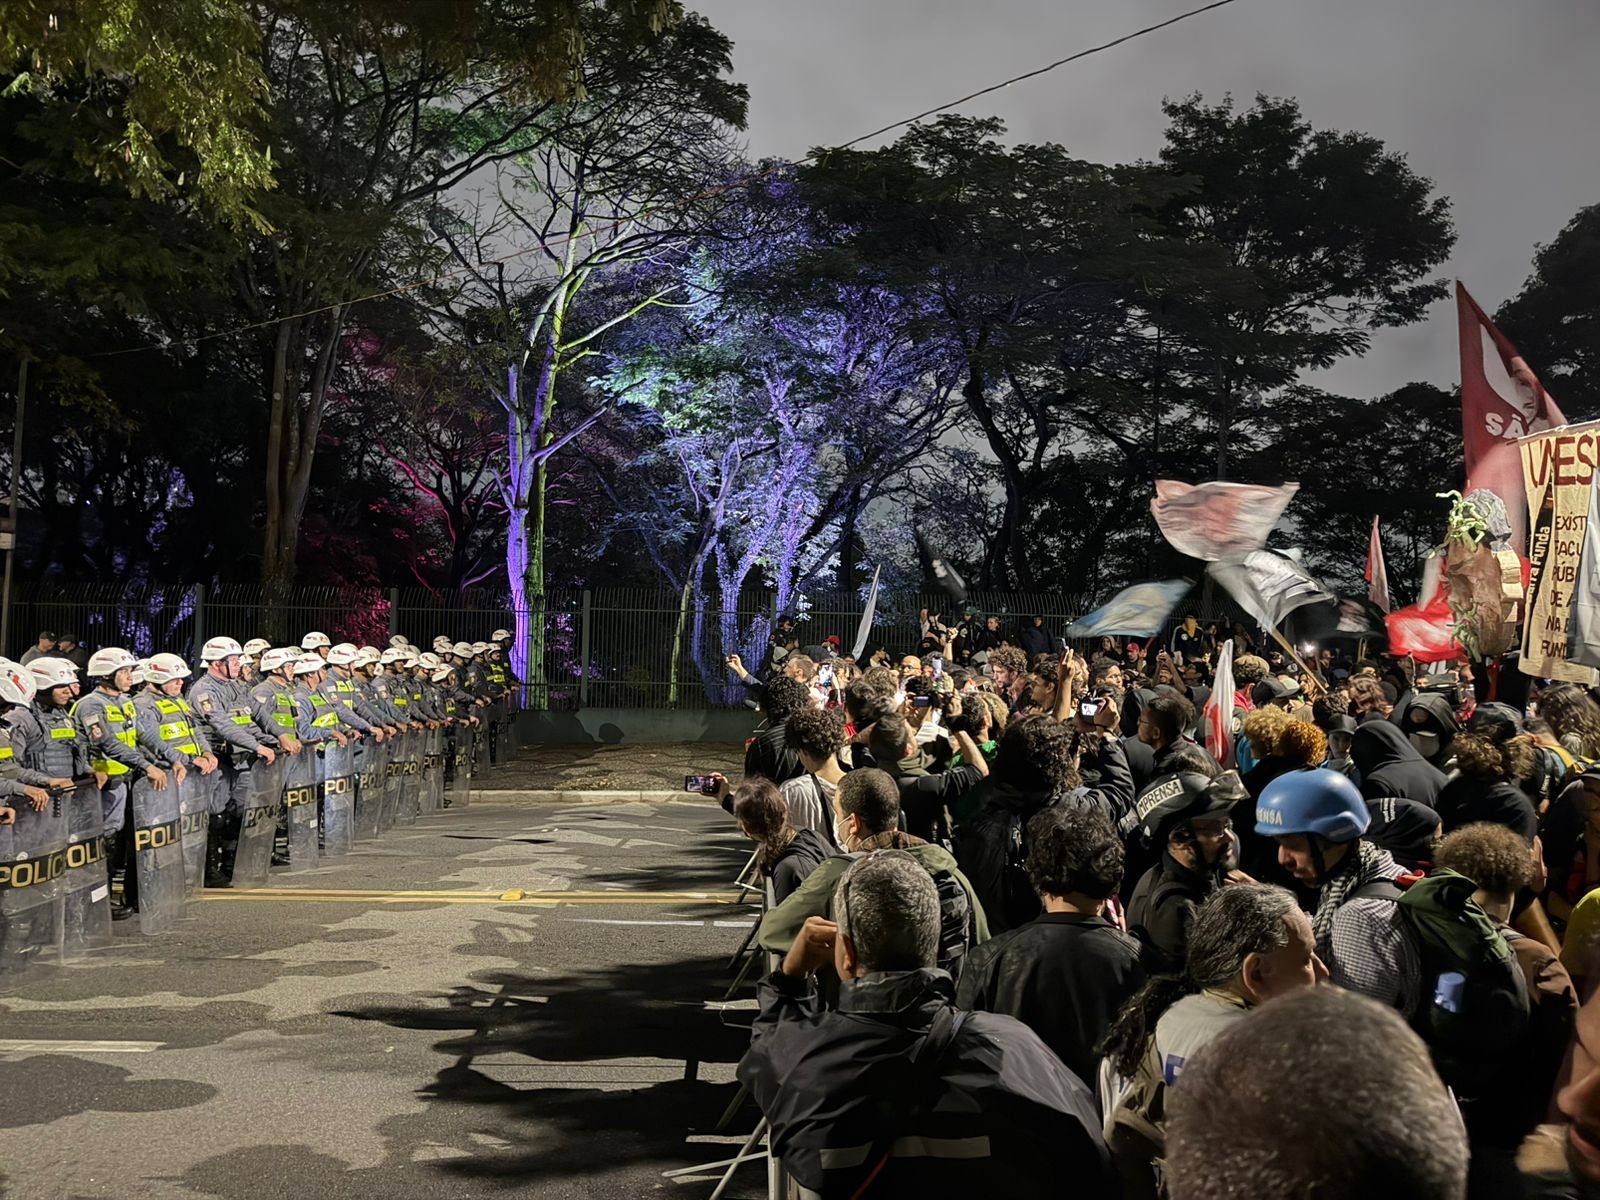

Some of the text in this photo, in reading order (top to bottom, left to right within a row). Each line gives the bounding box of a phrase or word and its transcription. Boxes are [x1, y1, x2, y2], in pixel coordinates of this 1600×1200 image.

[1485, 412, 1525, 439] SÃ
[1534, 526, 1550, 566] Funda
[1552, 561, 1575, 583] PÚB
[1551, 590, 1563, 607] DE
[1545, 615, 1561, 632] NA
[287, 786, 317, 808] POL
[324, 777, 354, 797] POL
